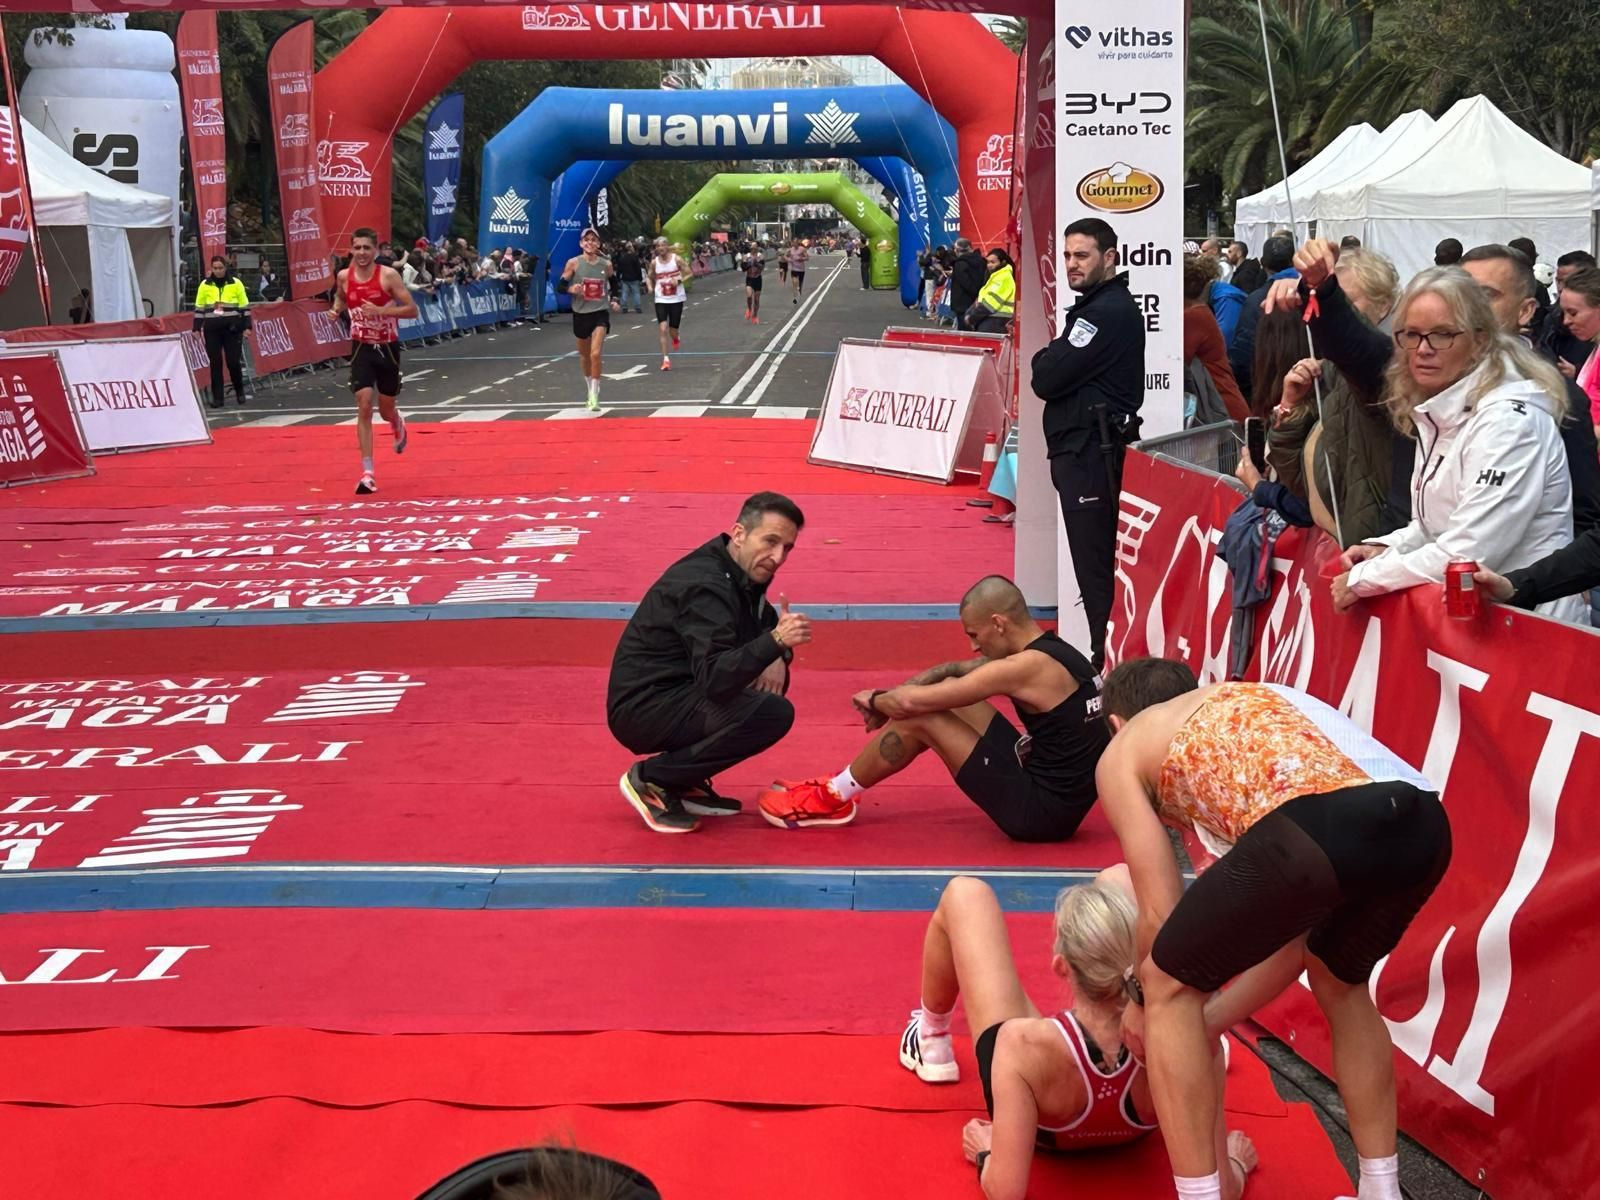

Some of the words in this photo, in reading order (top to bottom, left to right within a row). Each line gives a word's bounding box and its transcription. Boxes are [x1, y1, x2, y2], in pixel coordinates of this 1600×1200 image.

[595, 3, 825, 31] GENERALI
[1098, 26, 1173, 47] vithas
[1065, 92, 1172, 115] BYD
[609, 101, 788, 146] luanvi
[1066, 123, 1138, 136] Caetano
[1141, 122, 1171, 135] Tec
[320, 183, 370, 197] NERALI
[977, 178, 1012, 191] GENE
[1086, 184, 1153, 197] Gourmet
[489, 221, 529, 235] luanvi
[1115, 242, 1171, 266] ldin
[72, 379, 176, 412] ENERALI
[864, 390, 957, 433] GENERALI
[1476, 469, 1506, 486] HH
[85, 574, 432, 592] GENERALI
[0, 944, 210, 985] LI
